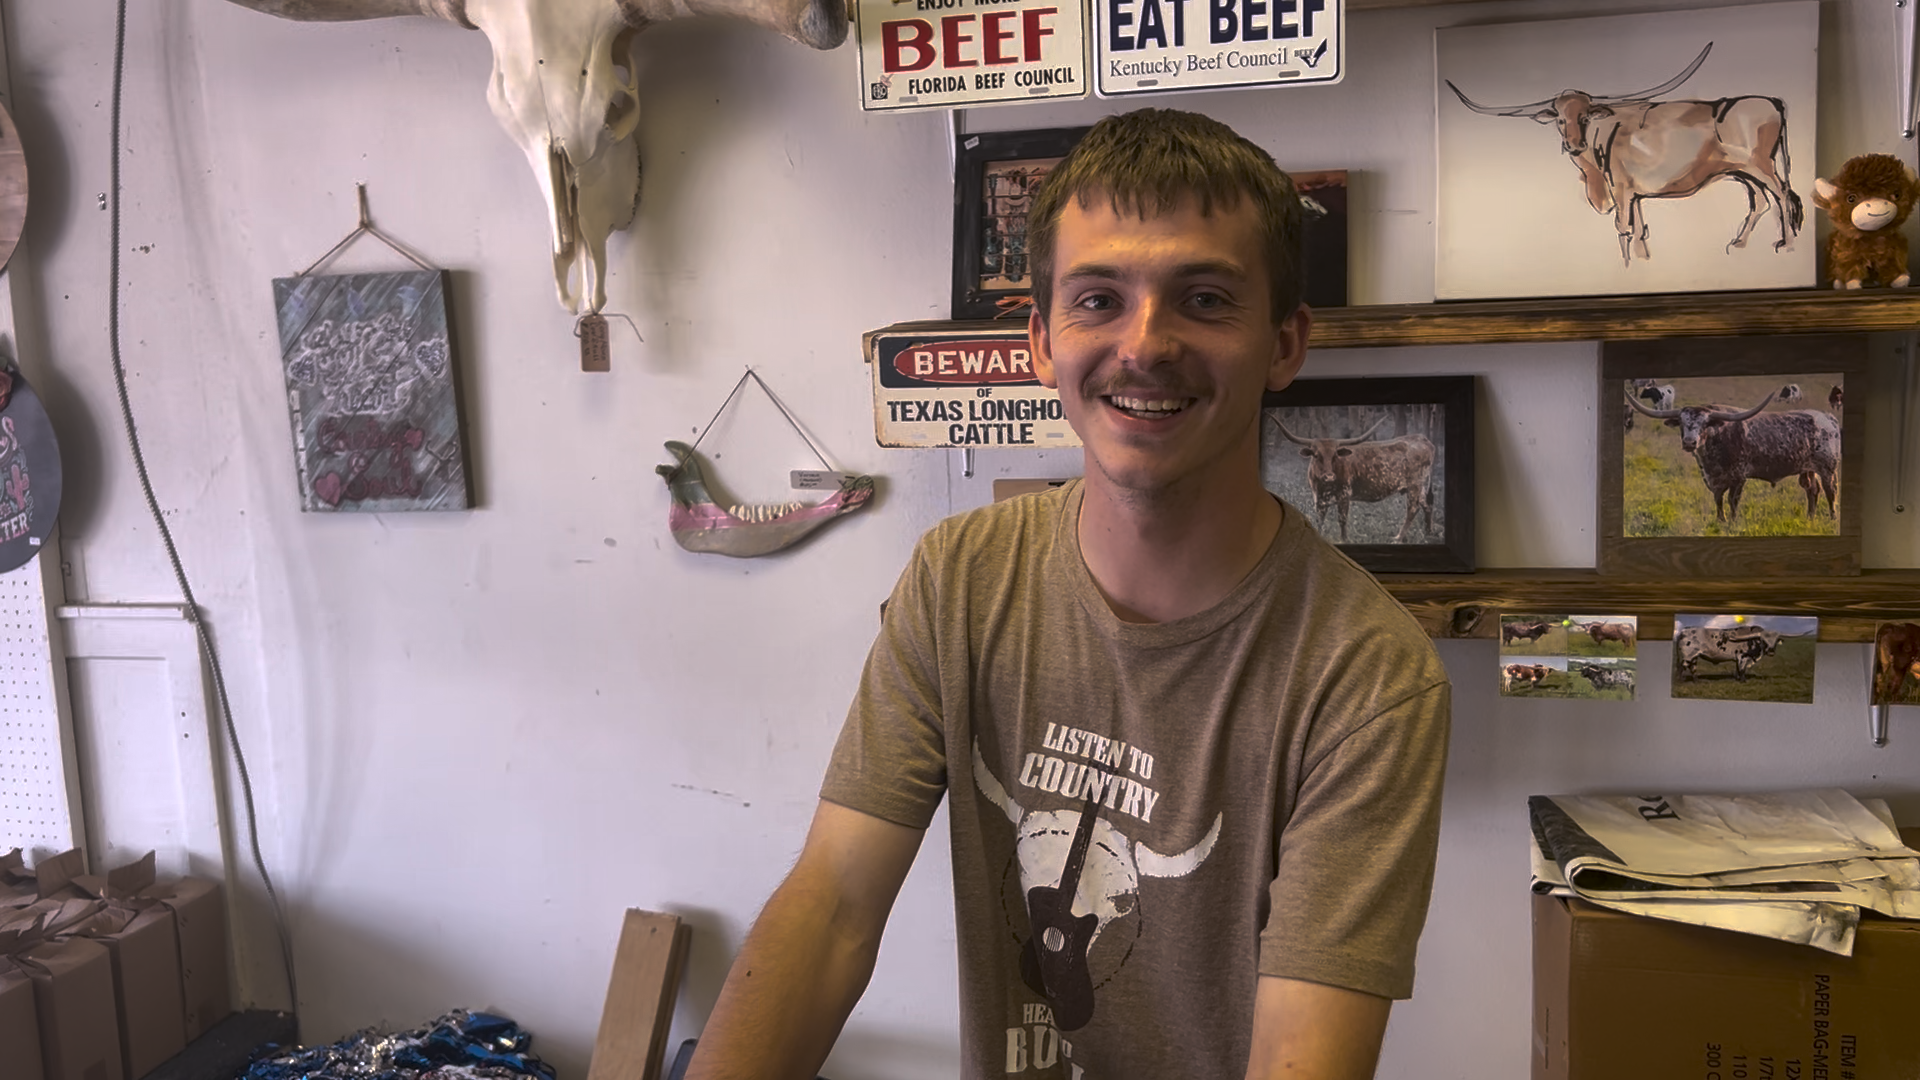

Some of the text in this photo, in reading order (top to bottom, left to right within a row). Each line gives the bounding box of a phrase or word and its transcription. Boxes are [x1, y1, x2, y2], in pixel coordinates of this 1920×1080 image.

[1109, 0, 1325, 51] EAT BEEF
[882, 7, 1058, 73] BEEF
[1110, 48, 1288, 77] Kentucky Beef Council
[909, 75, 967, 95] FLORIDA
[975, 72, 1006, 90] BEEF
[1014, 67, 1075, 87] COUNCIL
[914, 349, 1031, 375] BEWAR
[976, 387, 993, 398] OF
[887, 399, 1068, 422] TEXAS LONGHO
[949, 423, 1035, 445] CATTLE
[0, 512, 30, 542] TER
[1042, 722, 1154, 780] LISTEN TO
[1019, 752, 1160, 823] COUNTRY
[1814, 974, 1830, 1017] PAPER
[1023, 1003, 1057, 1027] HEA
[1707, 1042, 1722, 1068] 300
[1841, 1034, 1857, 1068] ITEM
[1733, 1055, 1748, 1078] 110
